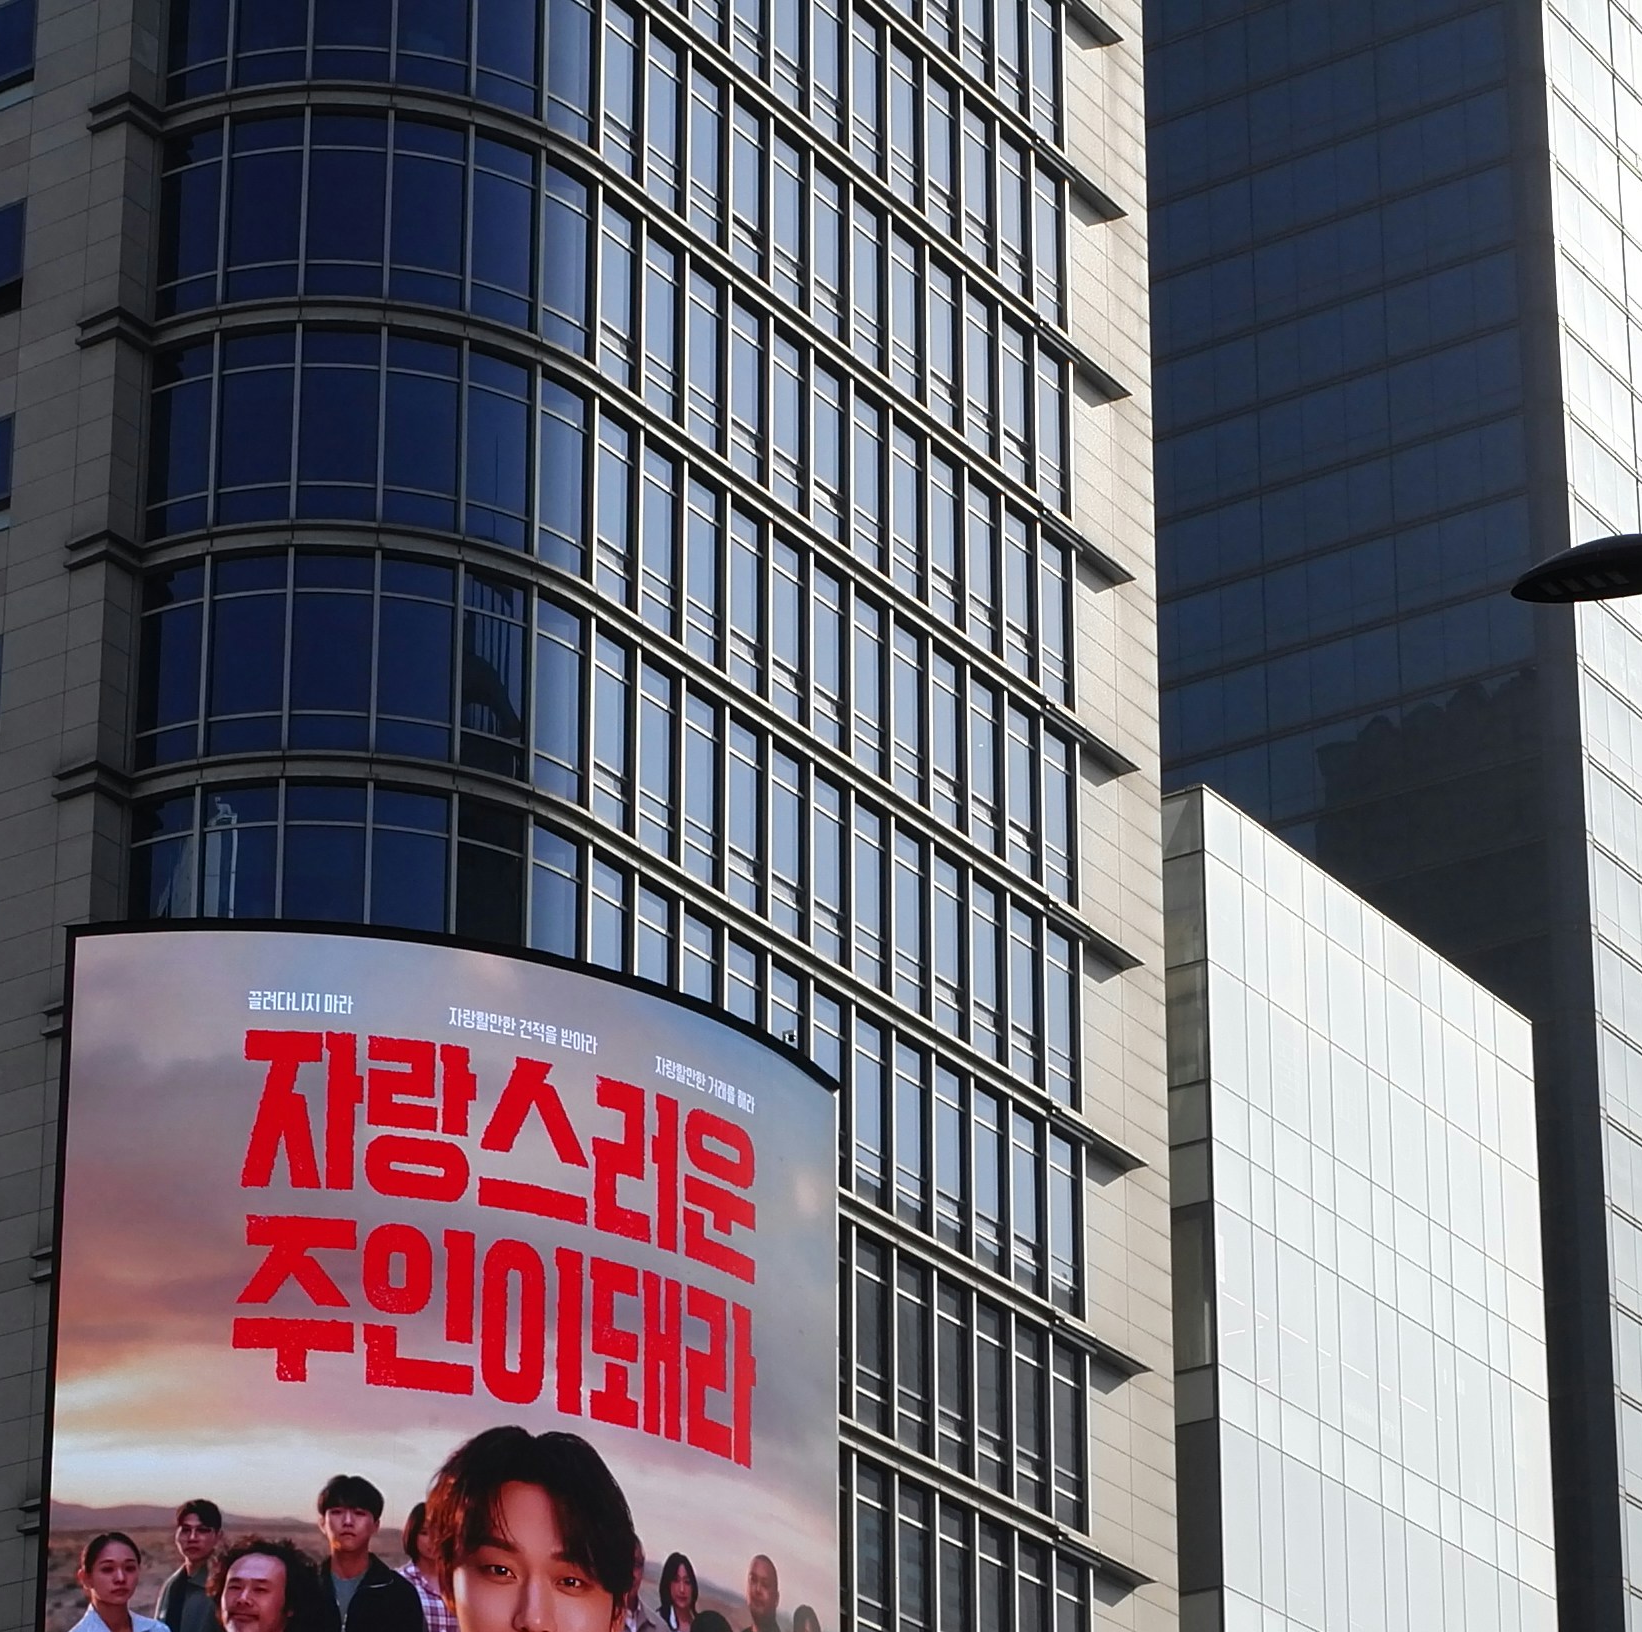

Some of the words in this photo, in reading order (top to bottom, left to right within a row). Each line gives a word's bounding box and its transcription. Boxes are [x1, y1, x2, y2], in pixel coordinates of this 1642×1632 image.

[248, 990, 320, 1011] 끌려다니지
[324, 992, 354, 1014] 마라
[449, 1006, 516, 1036] 자랑할만한
[519, 1018, 557, 1046] 견적을
[560, 1029, 598, 1055] 받아라
[655, 1055, 706, 1093] 자랑할만한
[708, 1075, 736, 1106] 거래를
[737, 1088, 755, 1114] 해라
[241, 1029, 757, 1284] 자랑스러운
[232, 1213, 756, 1469] 주인이돼라
